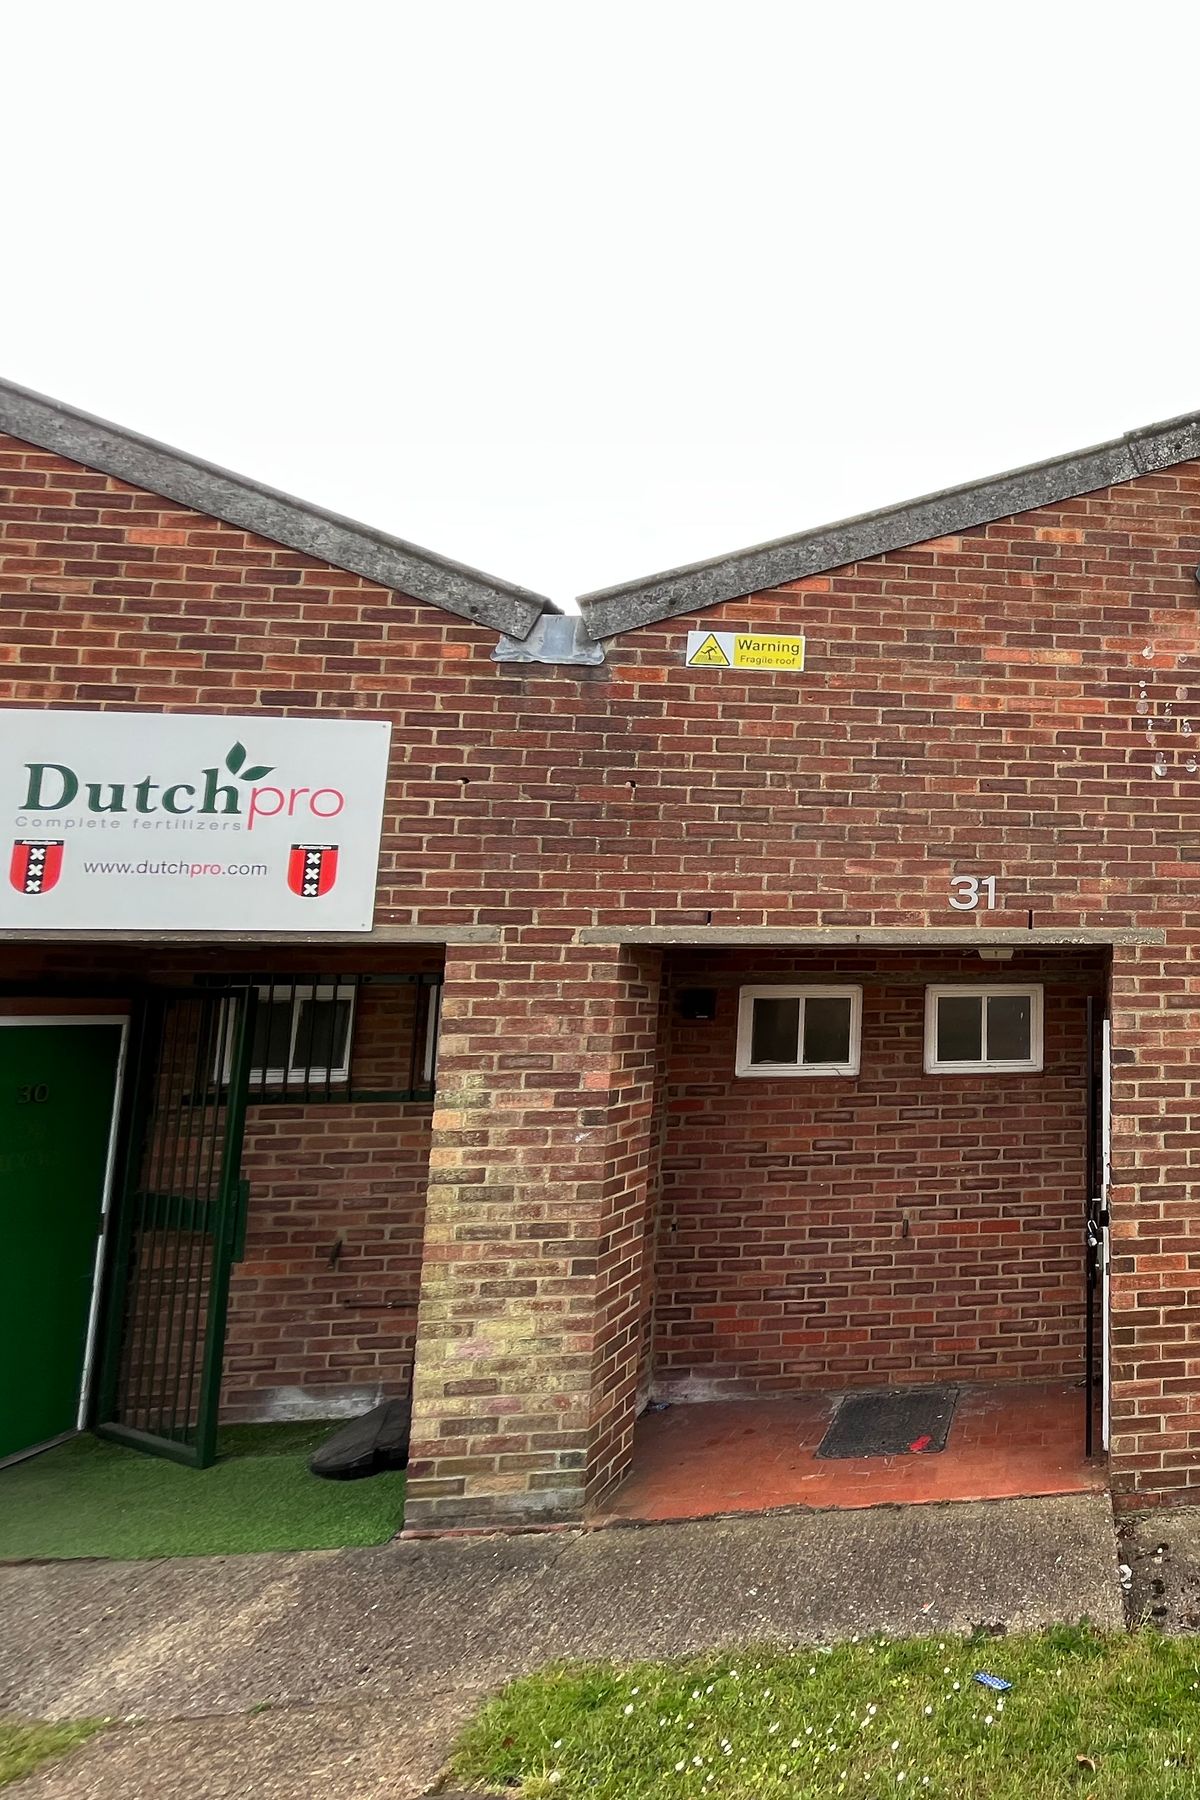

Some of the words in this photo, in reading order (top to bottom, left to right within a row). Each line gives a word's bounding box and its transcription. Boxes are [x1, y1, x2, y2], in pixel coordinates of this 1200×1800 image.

[738, 639, 800, 656] Warning
[740, 655, 773, 666] Fragile
[775, 657, 796, 666] roof
[15, 815, 121, 831] Complete
[133, 817, 242, 831] fertilizers
[84, 860, 268, 878] www.dutchpro.com
[948, 875, 997, 910] 31
[16, 1082, 50, 1104] 30
